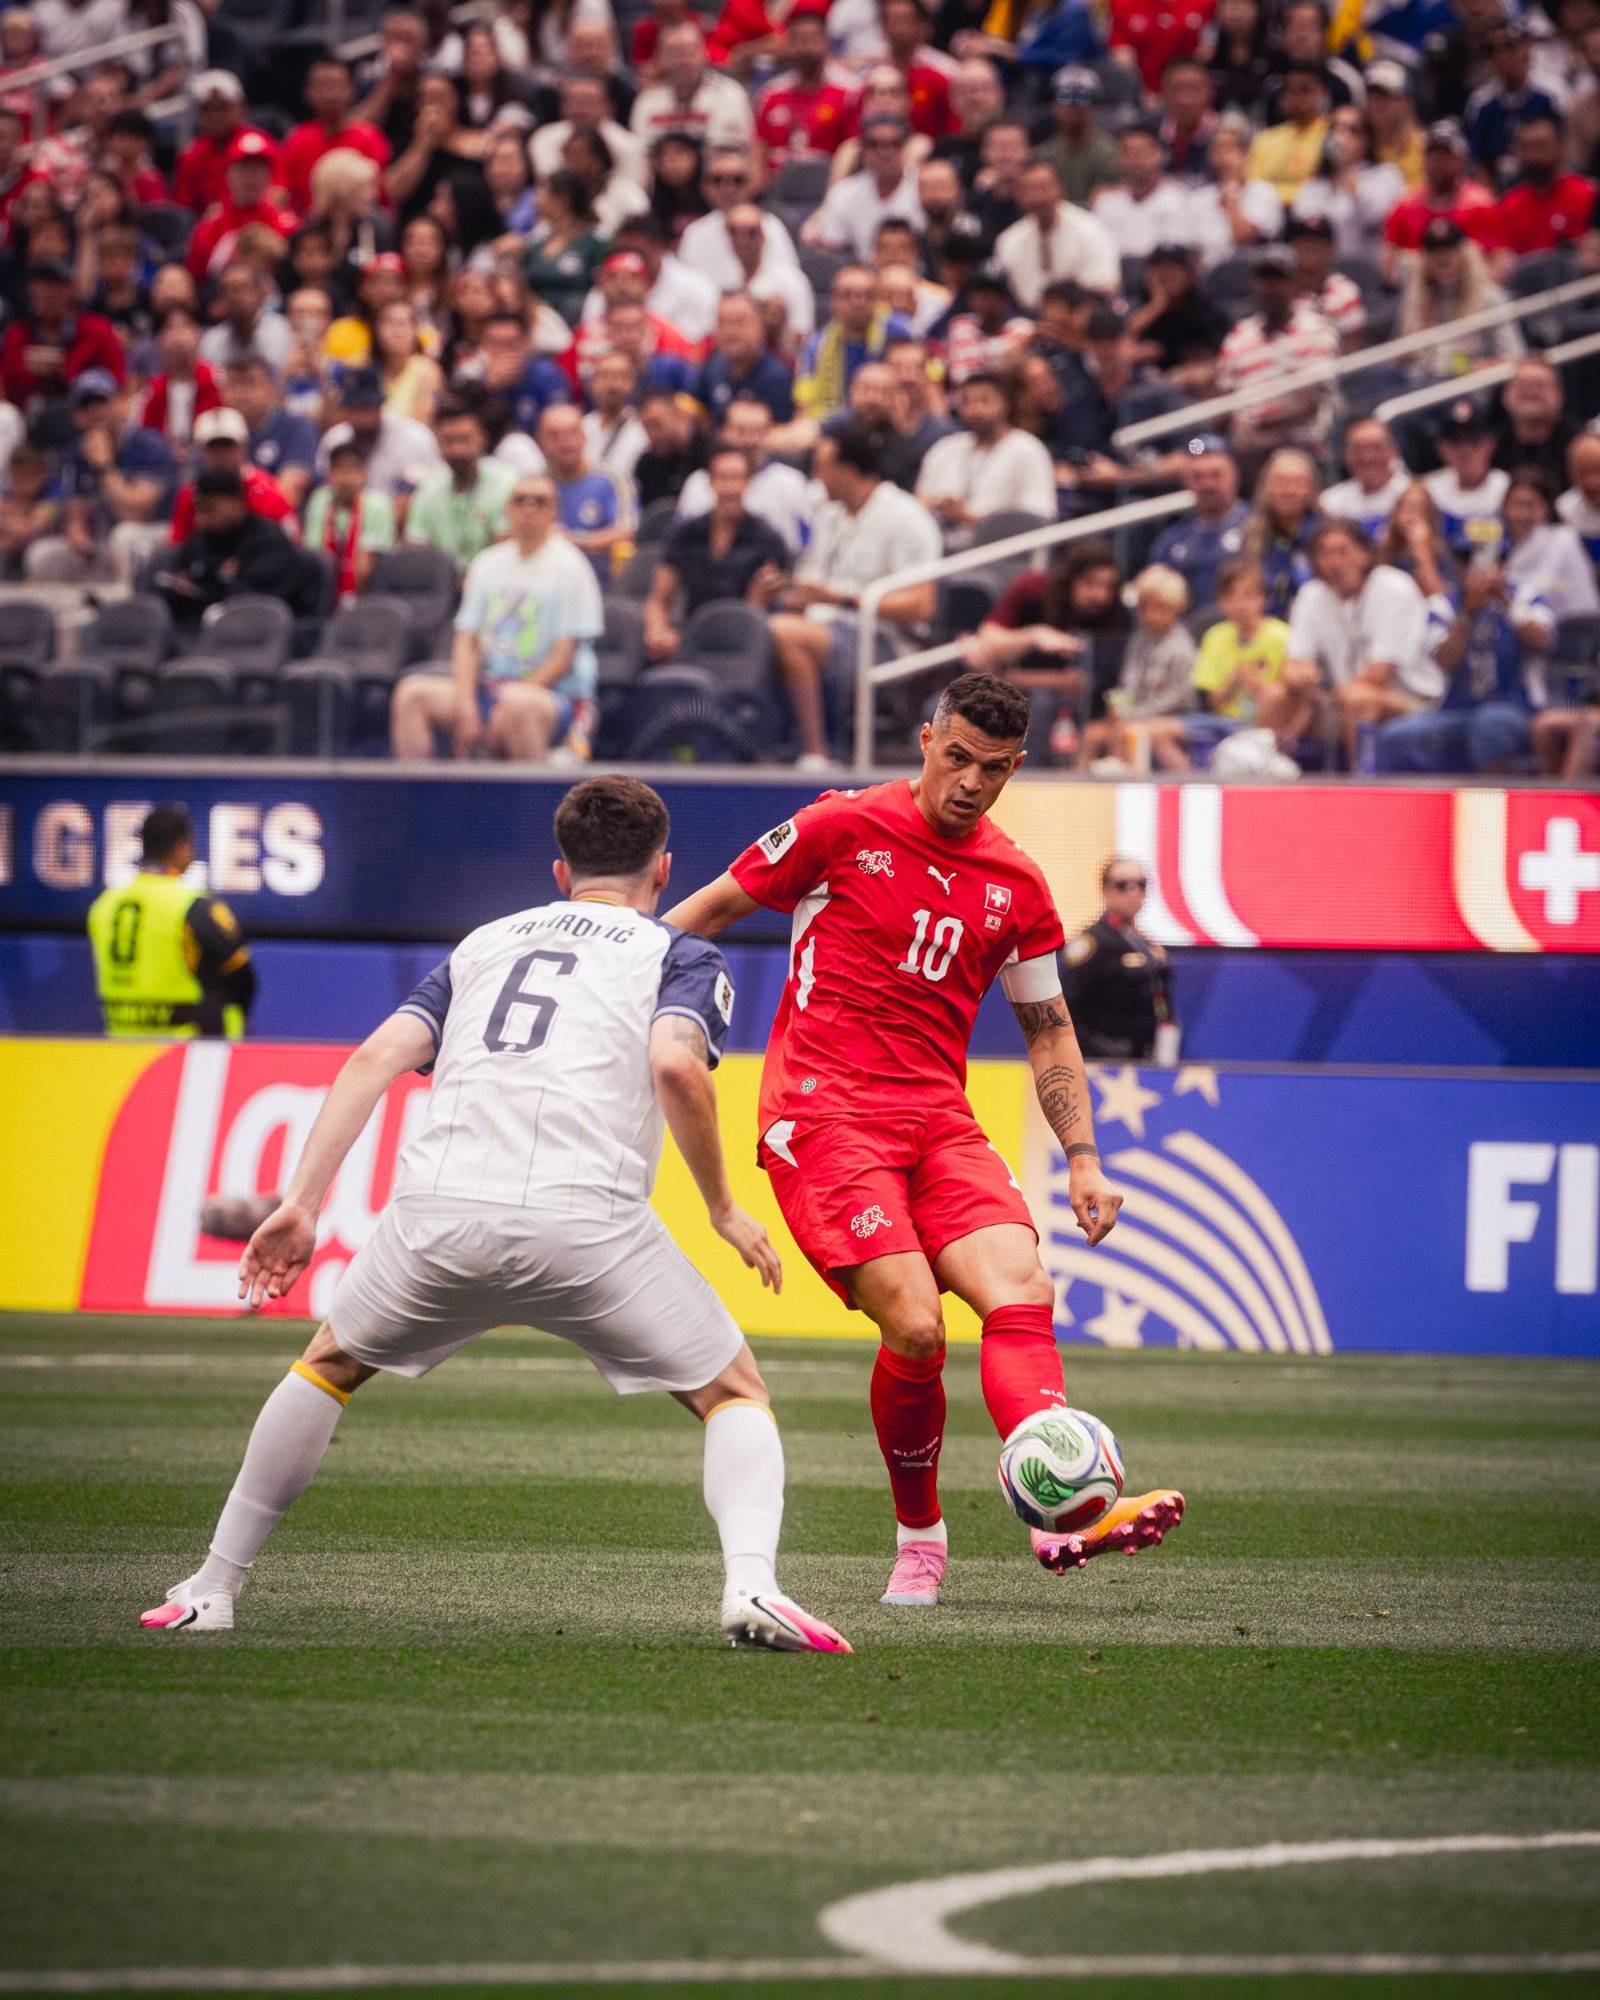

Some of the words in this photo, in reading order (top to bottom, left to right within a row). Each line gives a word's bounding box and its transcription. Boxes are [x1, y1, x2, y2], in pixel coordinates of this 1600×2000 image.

[897, 908, 965, 983] 10
[482, 948, 580, 1056] 6
[1465, 1141, 1600, 1295] FI
